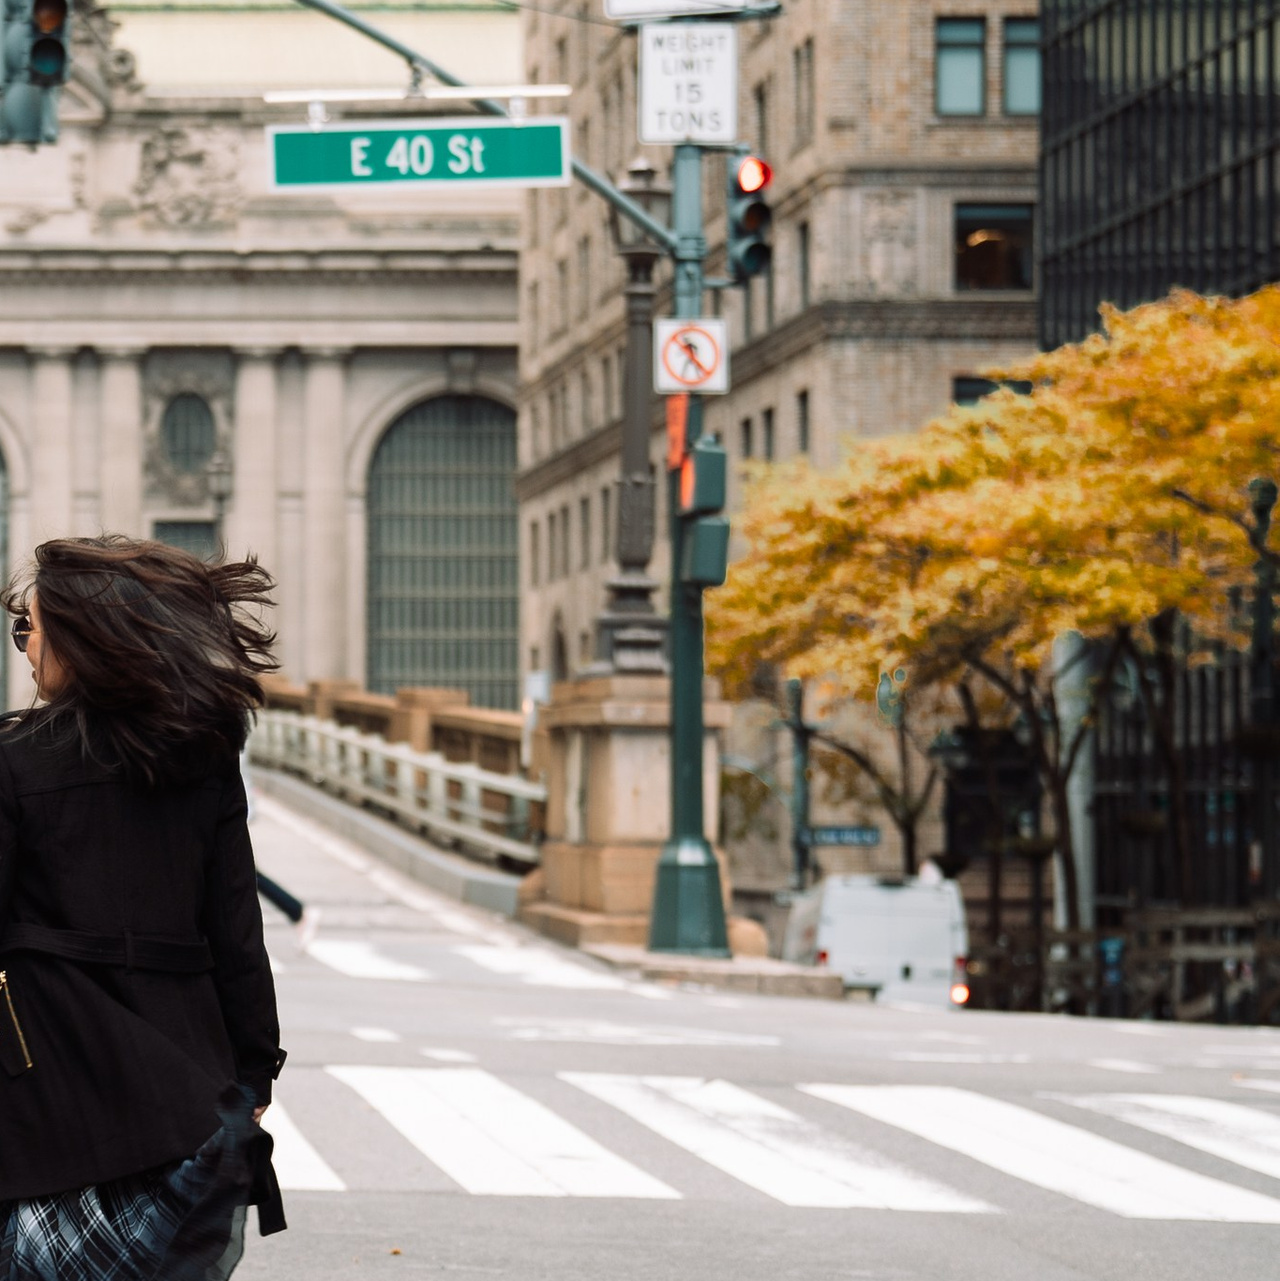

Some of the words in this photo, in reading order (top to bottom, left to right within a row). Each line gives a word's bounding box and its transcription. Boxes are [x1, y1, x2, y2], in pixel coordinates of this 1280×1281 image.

[652, 35, 727, 54] WEIGHT
[662, 58, 715, 77] LIMIT
[674, 83, 703, 104] 15
[656, 111, 723, 133] TONS
[350, 137, 372, 176] E
[385, 135, 434, 175] 40
[447, 134, 485, 174] St
